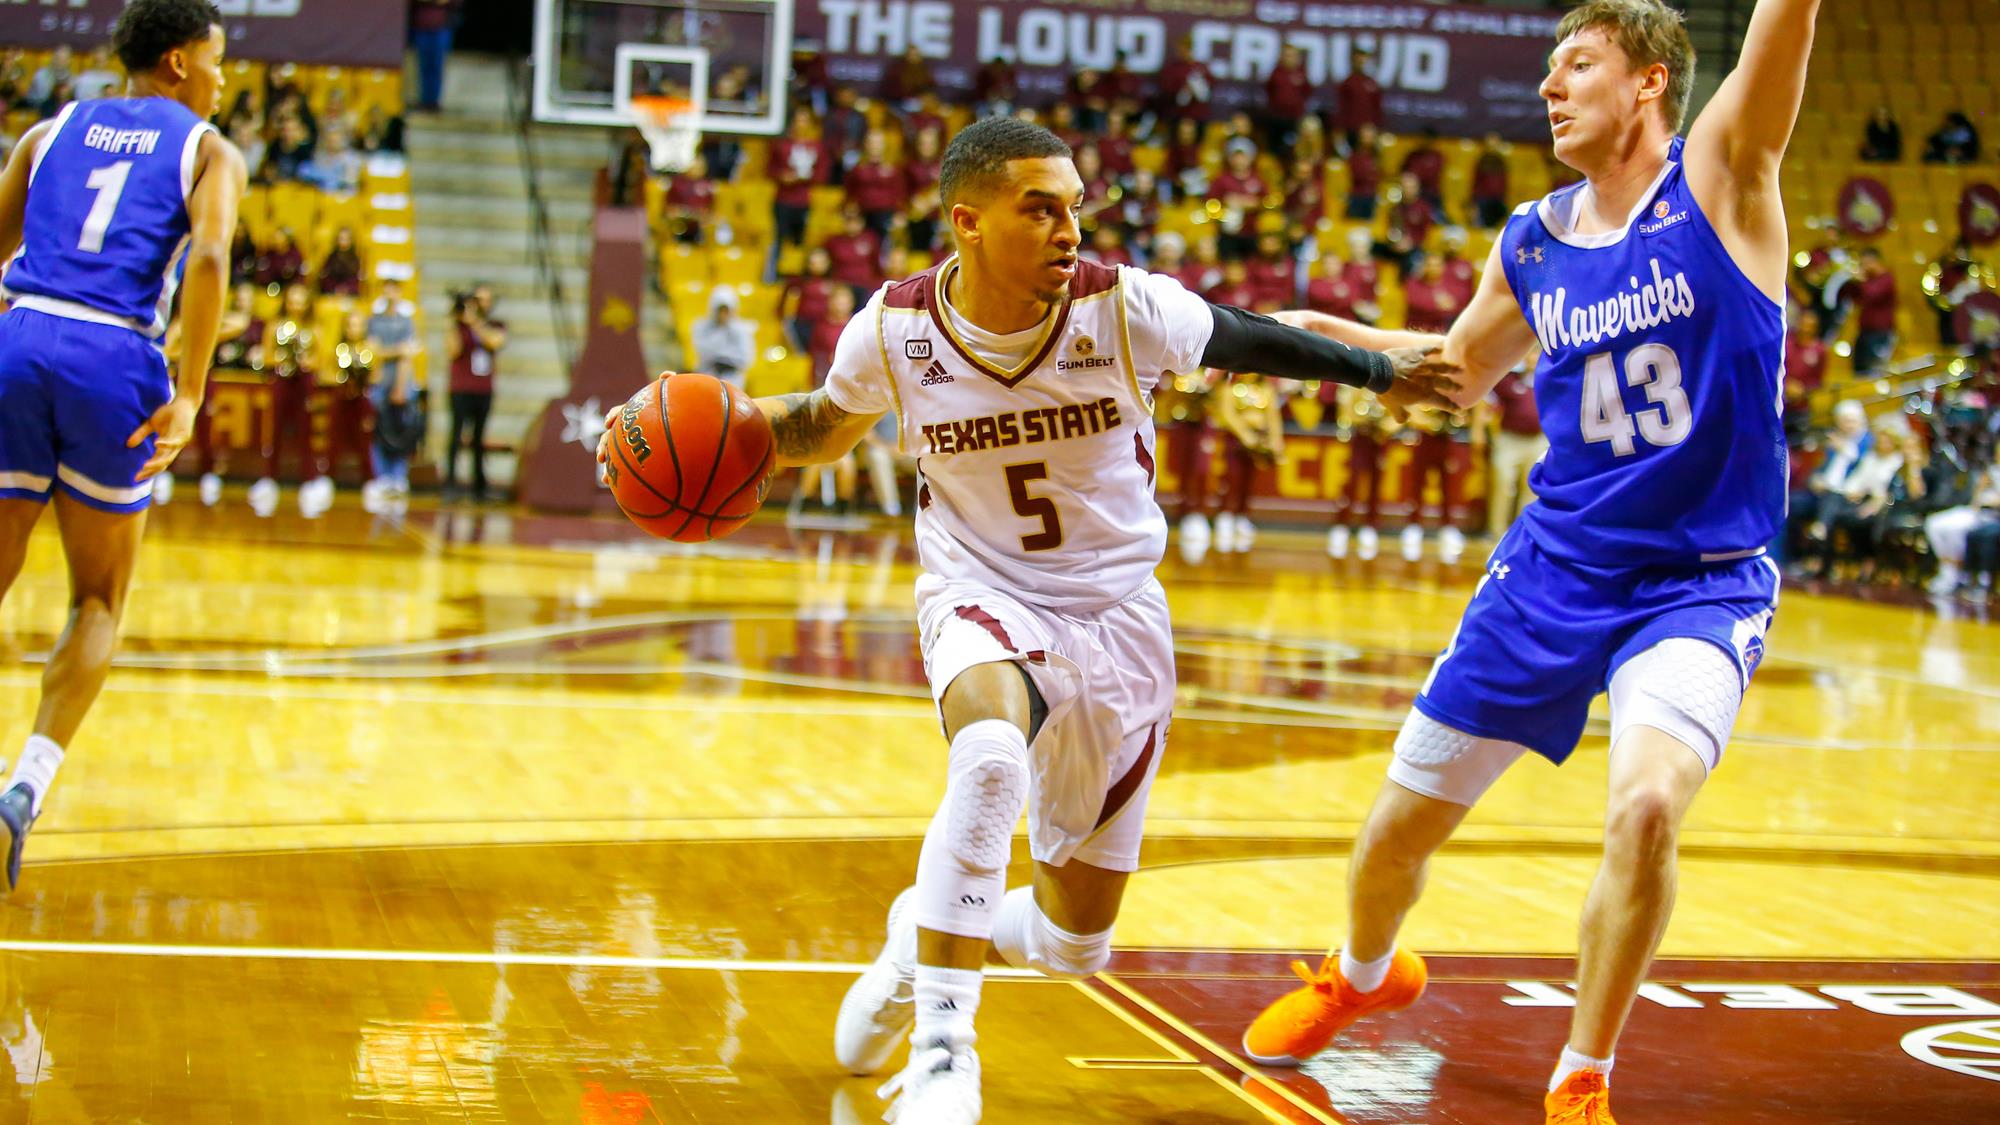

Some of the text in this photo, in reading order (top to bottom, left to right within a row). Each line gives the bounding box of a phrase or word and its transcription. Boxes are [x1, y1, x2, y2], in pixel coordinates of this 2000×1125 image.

[819, 1, 953, 59] THE
[976, 8, 1166, 73] LOUD
[84, 123, 161, 155] GRIFFIN
[77, 160, 134, 255] 1
[1639, 211, 1687, 234] SUN BELT
[1531, 258, 1695, 356] Mavericks
[921, 373, 955, 387] adidas
[1057, 357, 1116, 371] SUN BELT
[921, 397, 1122, 456] TEXAS STATE
[1580, 343, 1693, 458] 43
[1002, 460, 1064, 552] 5
